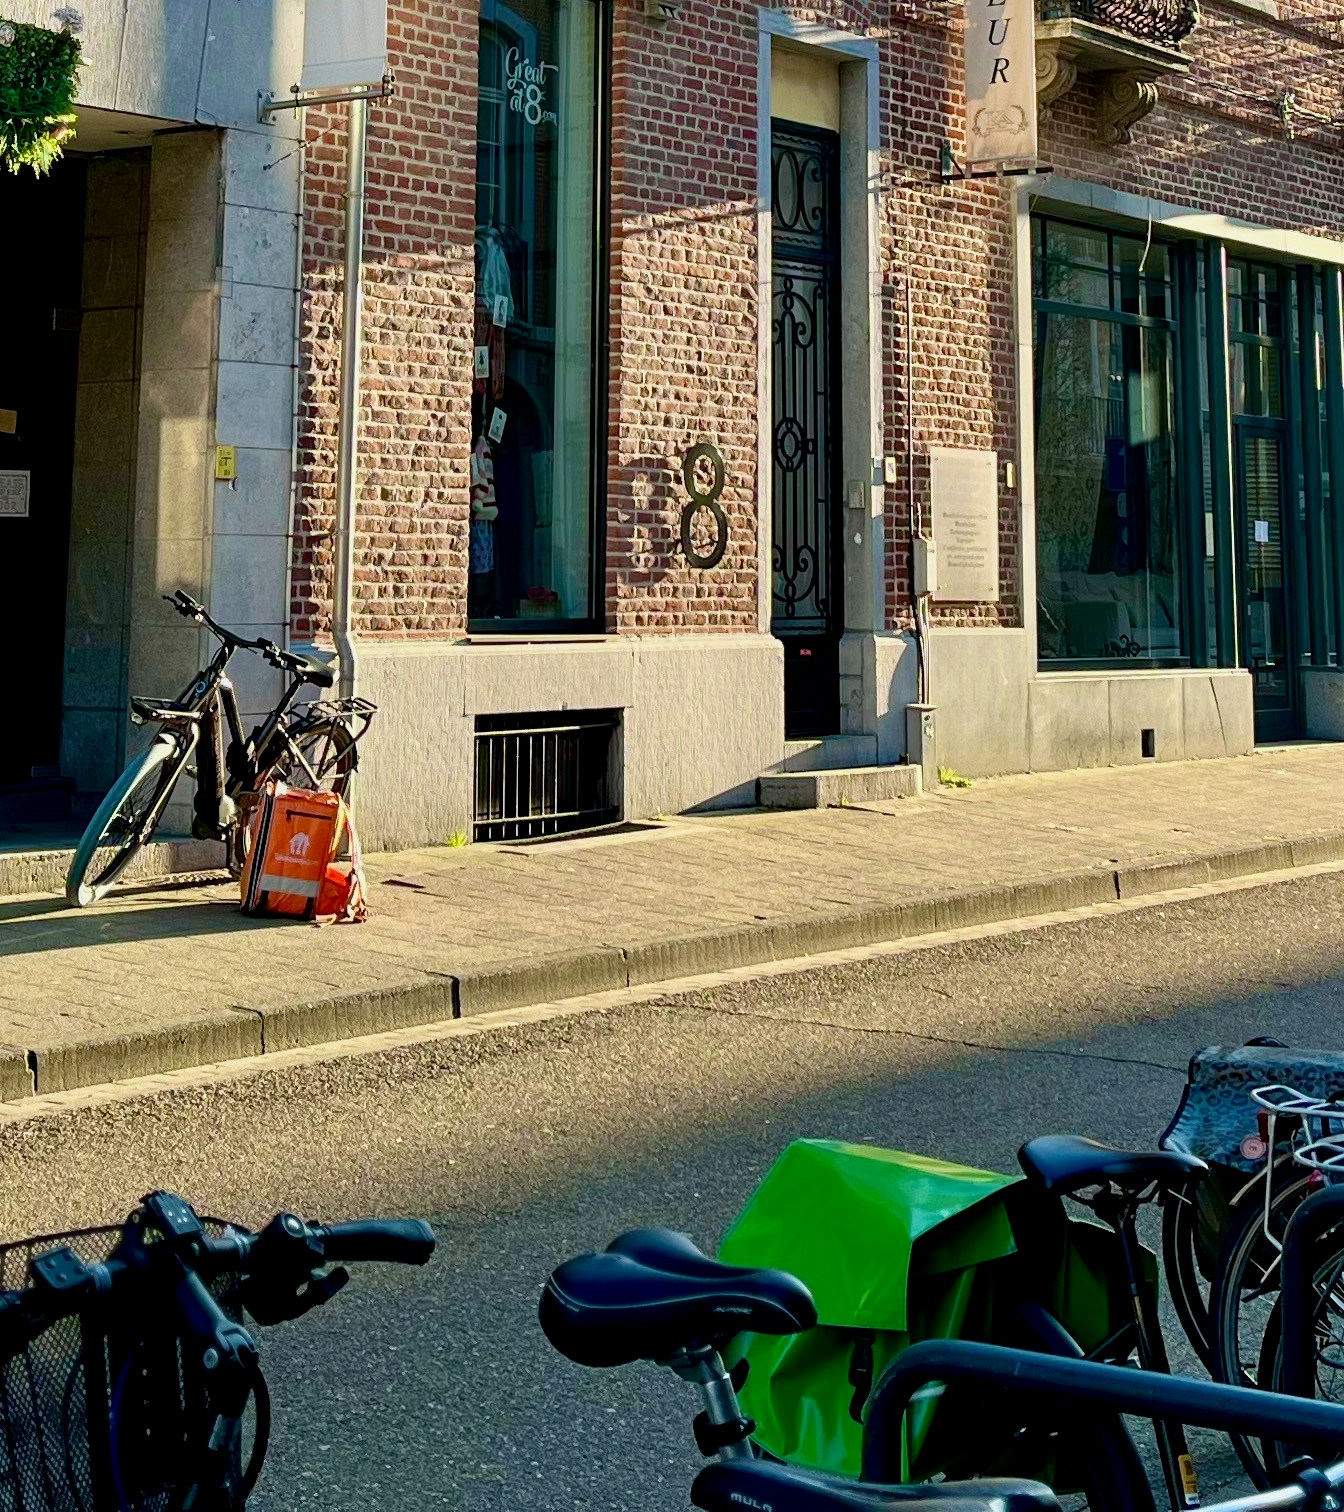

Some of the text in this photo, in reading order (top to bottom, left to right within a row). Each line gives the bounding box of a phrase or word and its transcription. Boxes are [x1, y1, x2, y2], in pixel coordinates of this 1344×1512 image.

[505, 46, 559, 91] Great
[509, 88, 526, 113] at
[681, 443, 728, 569] 8
